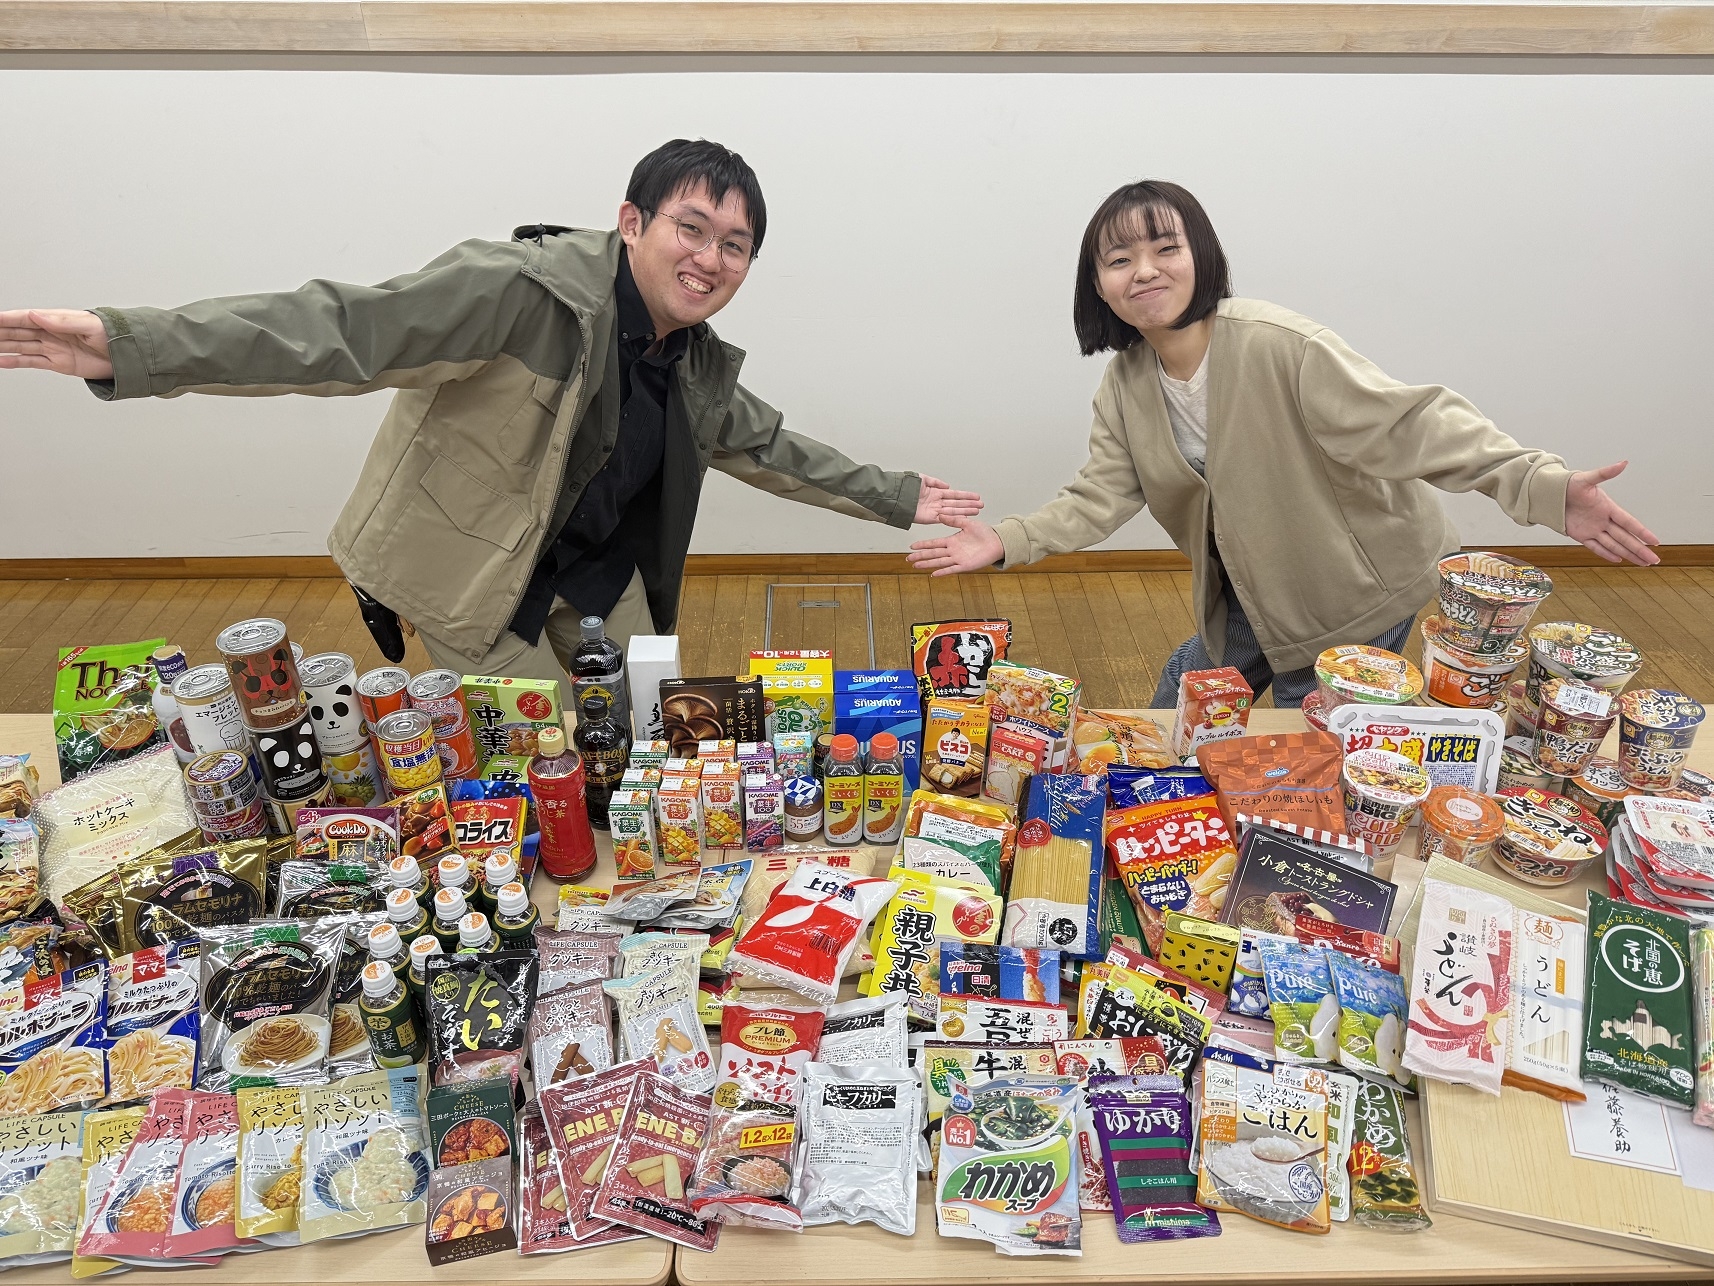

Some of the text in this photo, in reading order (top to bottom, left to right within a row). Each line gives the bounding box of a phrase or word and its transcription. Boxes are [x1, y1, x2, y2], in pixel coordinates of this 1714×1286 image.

[852, 675, 899, 683] AQUARIUS
[854, 699, 902, 707] AQUARIUS
[1051, 694, 1068, 712] 2
[736, 697, 748, 742] まるごと
[1213, 711, 1232, 719] Lipton
[1009, 716, 1050, 735] ホワイトソース
[1015, 725, 1033, 735] ハウス
[1371, 725, 1406, 735] ペヤング
[1196, 729, 1243, 742] アップル ルイボス
[1545, 731, 1599, 753] 鴨だし
[940, 740, 969, 754] ビスコ
[1002, 746, 1025, 757] CAKE
[1428, 738, 1478, 763] やきそば
[1628, 744, 1685, 765] 天ぷら
[1556, 752, 1580, 765] そば
[1636, 761, 1671, 776] うどん
[705, 789, 736, 797] 野菜生活
[830, 790, 859, 798] こいくち
[869, 789, 898, 797] こいくち
[1229, 794, 1334, 806] こだわりの焼ほしいも
[73, 798, 136, 826] ホットケーキ
[661, 805, 693, 814] 野菜生活
[1141, 806, 1183, 821] HAPPY TURN
[1359, 805, 1397, 820] BIG
[89, 812, 129, 831] ミックス
[612, 819, 645, 829] 野菜生活
[790, 818, 804, 828] 55
[1507, 797, 1594, 846] きつね
[1127, 859, 1198, 887] ハッピーパウダー!
[1141, 880, 1186, 895] とまらない
[1259, 854, 1374, 909] 小倉トーストラングドシャ
[804, 877, 857, 902] 上白糖
[1533, 918, 1554, 939] 麺
[658, 942, 688, 950] CAPSULE
[1459, 933, 1478, 957] 讃岐
[549, 953, 594, 966] クッキー
[880, 906, 936, 1000] 親子丼
[1622, 938, 1643, 973] そば
[1433, 931, 1474, 1007] うどん
[1643, 938, 1663, 986] 北国の恵
[971, 974, 990, 985] 日清
[124, 982, 178, 998] ミルクたっぷりの
[1339, 976, 1377, 1004] Puré
[1530, 955, 1552, 1024] うどん
[464, 968, 503, 1051] たい
[744, 1034, 791, 1044] PREMIUM
[1067, 1042, 1095, 1050] にんべん
[1210, 1051, 1234, 1063] Asahi
[972, 1051, 1009, 1080] 牛
[262, 1093, 281, 1103] LIFE
[344, 1086, 376, 1095] CAPSULE
[825, 1088, 895, 1105] ビーフカリー
[251, 1101, 302, 1117] やさし
[313, 1093, 389, 1115] やさしい
[453, 1100, 484, 1111] CHEESE
[585, 1104, 601, 1115] AST
[6, 1113, 66, 1128] LIFE CAPSULE
[315, 1108, 383, 1134] リゾット
[664, 1111, 679, 1120] AST
[1242, 1104, 1318, 1139] ごはん
[1358, 1080, 1397, 1151] わかめ
[0, 1121, 76, 1140] やさしい
[108, 1123, 128, 1132] LIFE
[563, 1113, 605, 1144] ENE
[635, 1111, 678, 1140] ENE
[949, 1131, 971, 1145] No.1
[1350, 1146, 1374, 1171] 12
[958, 1160, 1056, 1201] わかめ
[1004, 1199, 1039, 1212] スープ
